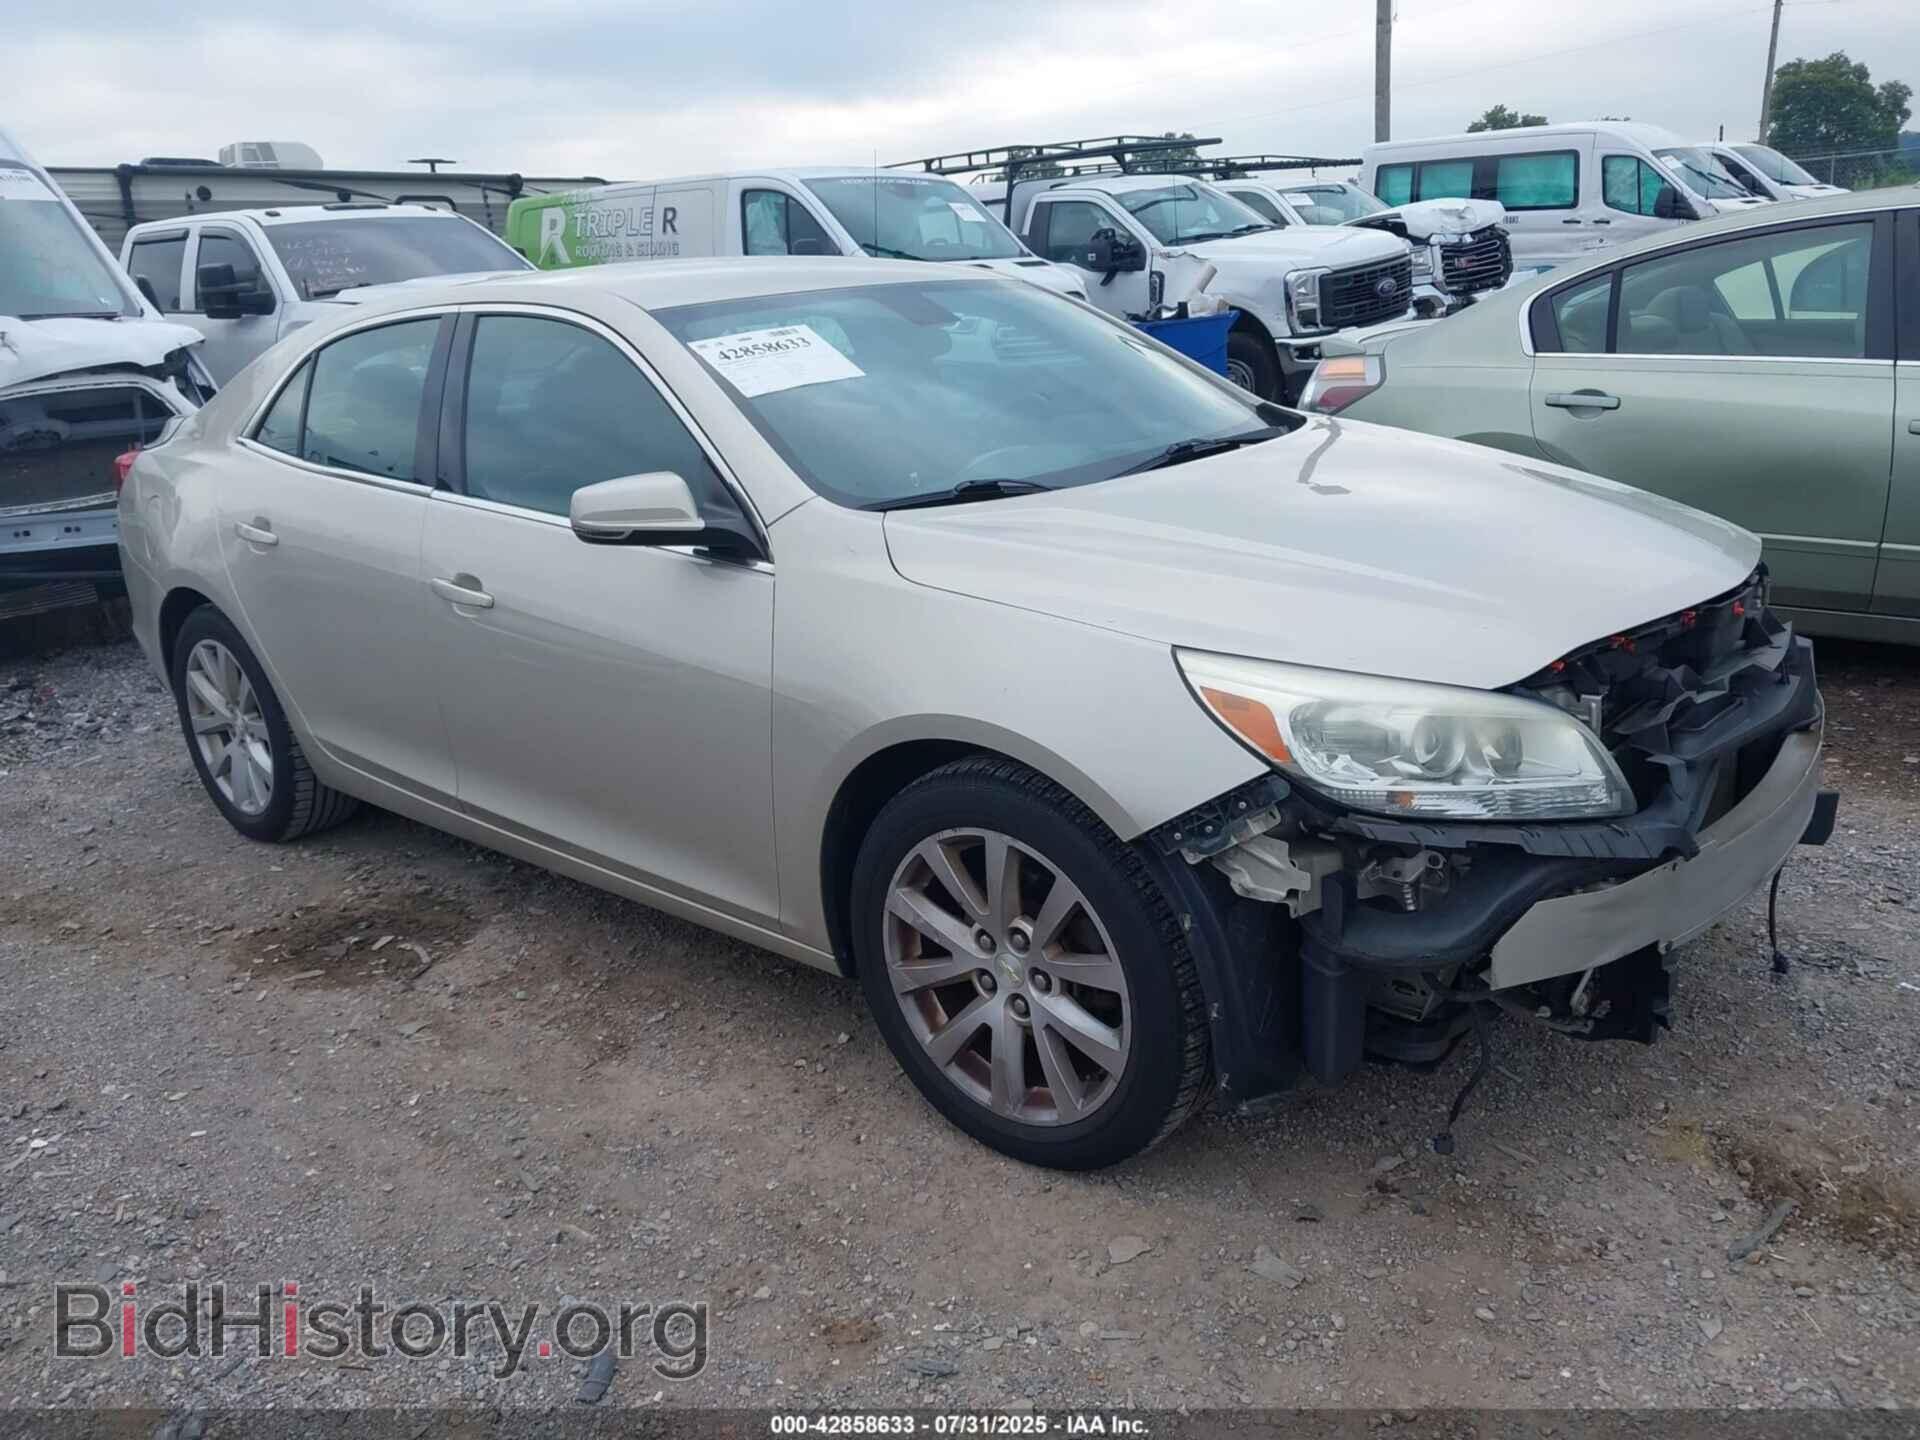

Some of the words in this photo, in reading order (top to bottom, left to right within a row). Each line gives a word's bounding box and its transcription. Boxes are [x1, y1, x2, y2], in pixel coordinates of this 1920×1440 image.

[574, 208, 653, 238] TRIPLE
[662, 207, 678, 234] R
[719, 337, 811, 360] 42858633
